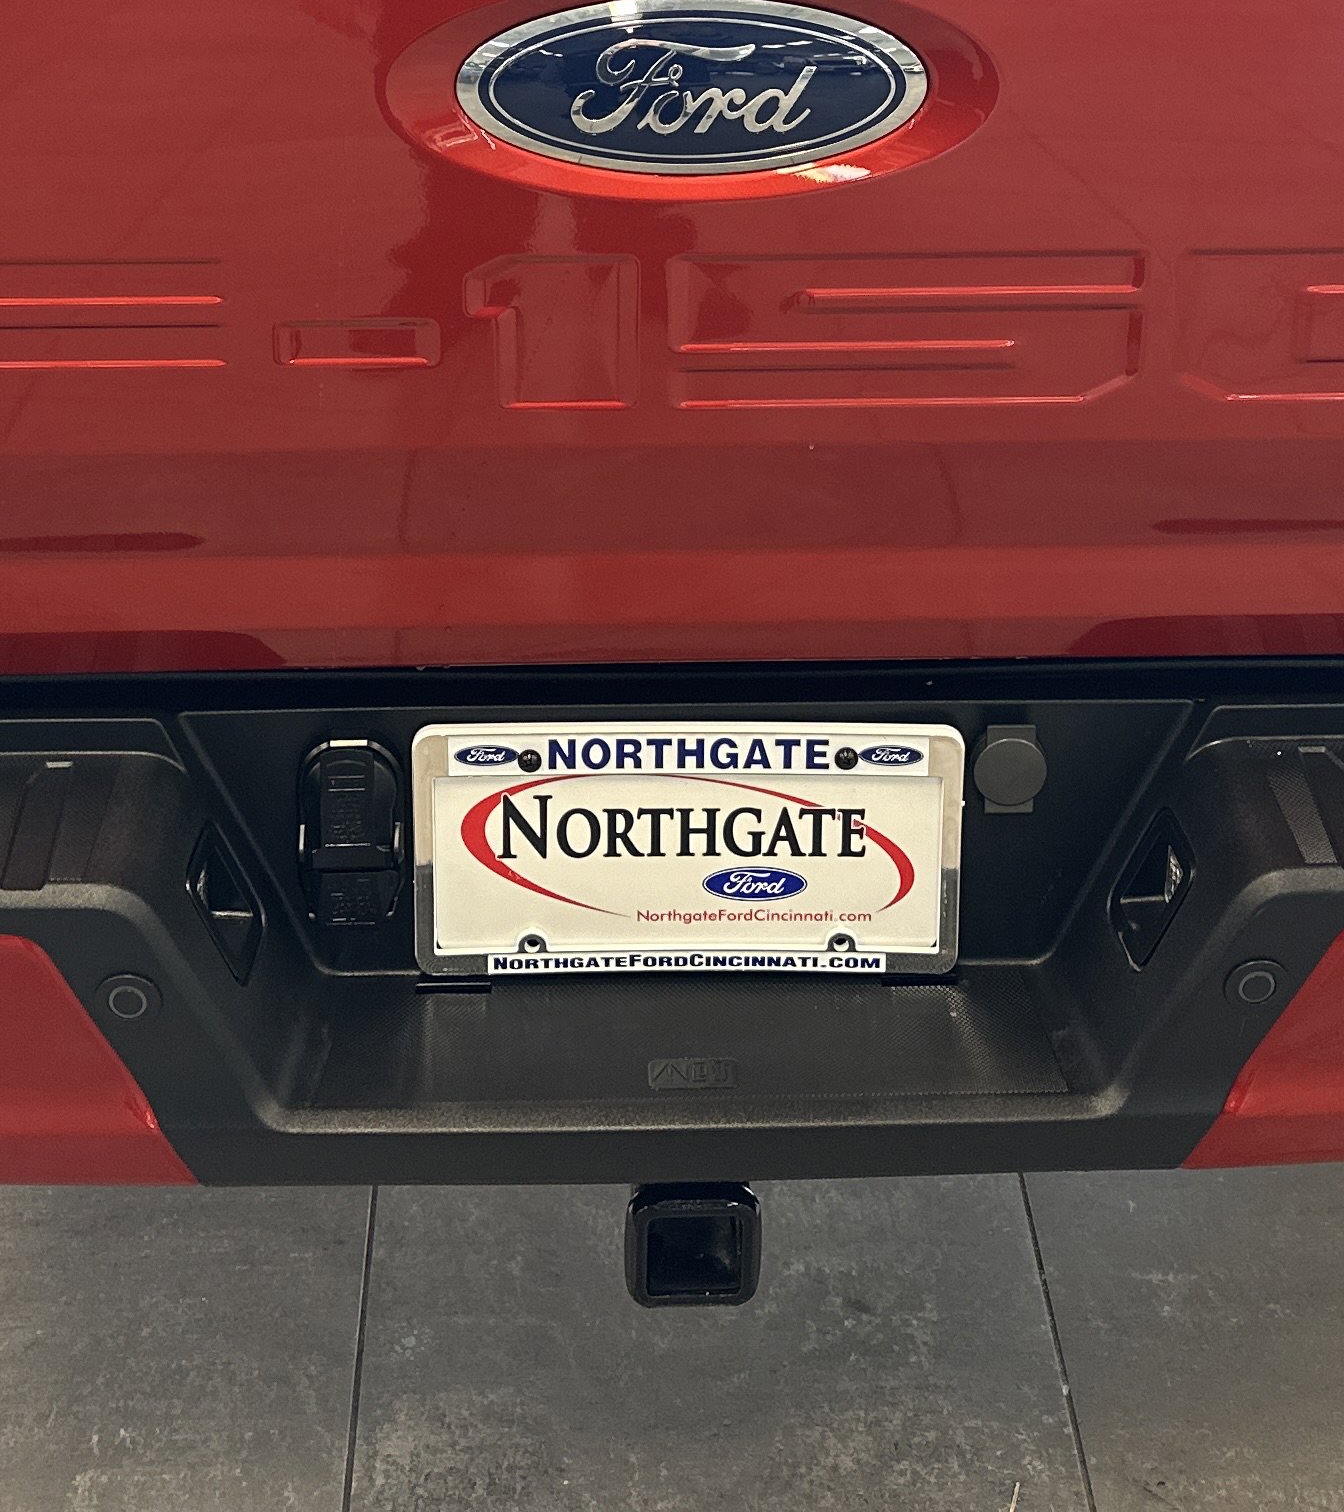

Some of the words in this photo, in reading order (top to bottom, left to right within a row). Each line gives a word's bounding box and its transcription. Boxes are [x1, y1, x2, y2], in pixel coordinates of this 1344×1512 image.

[570, 38, 818, 134] Ford
[466, 747, 506, 762] Ford
[547, 738, 830, 770] NORTHGATE
[871, 747, 911, 762] Ford
[497, 793, 866, 859] NORTHGATE
[723, 871, 785, 894] Ford
[636, 909, 872, 925] NorthgateFordCincinnati.com
